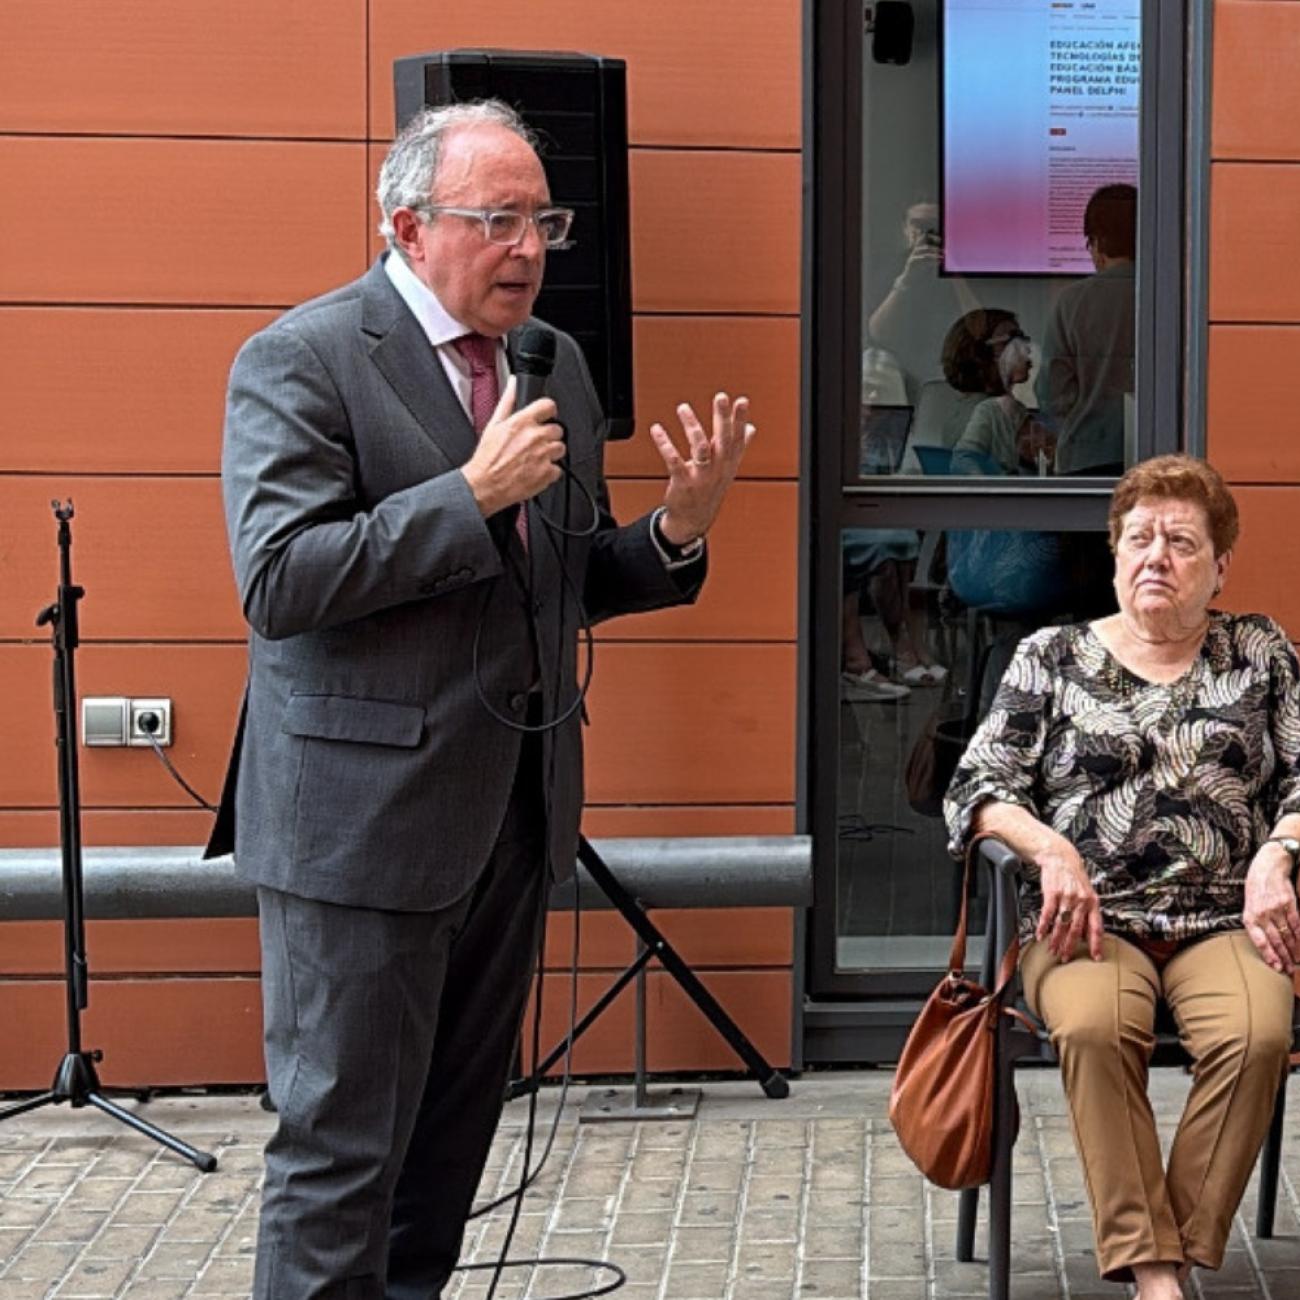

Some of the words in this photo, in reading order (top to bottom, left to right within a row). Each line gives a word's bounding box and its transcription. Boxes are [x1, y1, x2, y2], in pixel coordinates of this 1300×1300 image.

[1050, 39, 1114, 49] EDUCACIÓN
[1050, 51, 1125, 61] TECNOLOGÍAS
[1050, 62, 1114, 72] EDUCACIÓN
[1050, 75, 1111, 84] PROGRAMA
[1050, 85, 1084, 95] PANEL
[1088, 86, 1127, 96] DELPHI
